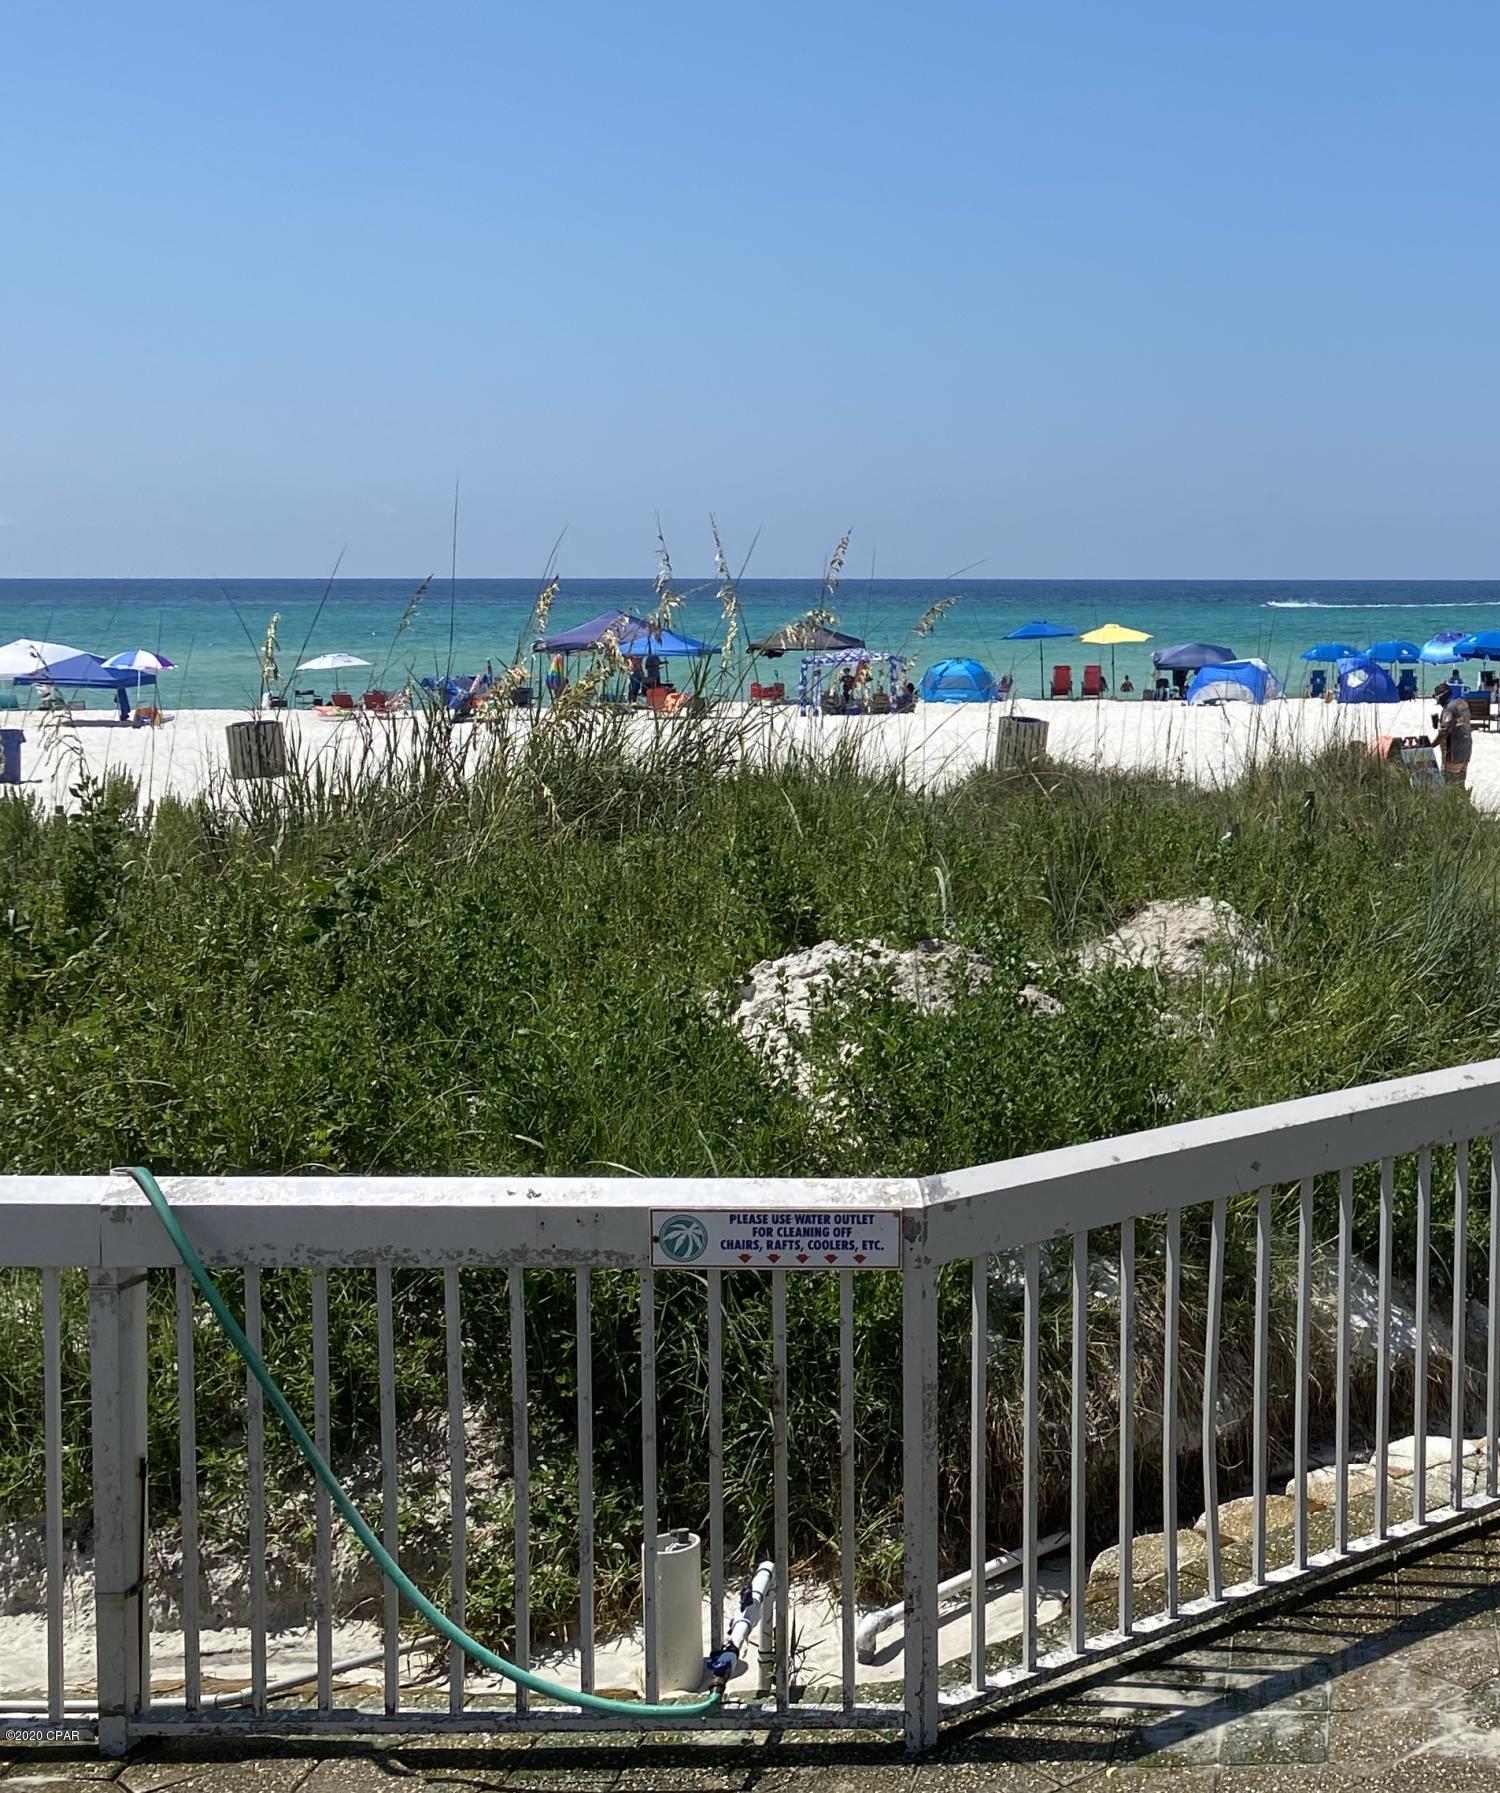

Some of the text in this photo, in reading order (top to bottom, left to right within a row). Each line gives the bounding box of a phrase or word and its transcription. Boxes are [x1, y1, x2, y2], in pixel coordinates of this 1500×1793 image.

[730, 1214, 875, 1225] PLEASE USE WATER OUTLET
[752, 1227, 853, 1238] FOR CLEANING OFF
[720, 1240, 884, 1252] CHAIRS, RAFTS, COOLERS, ETC.
